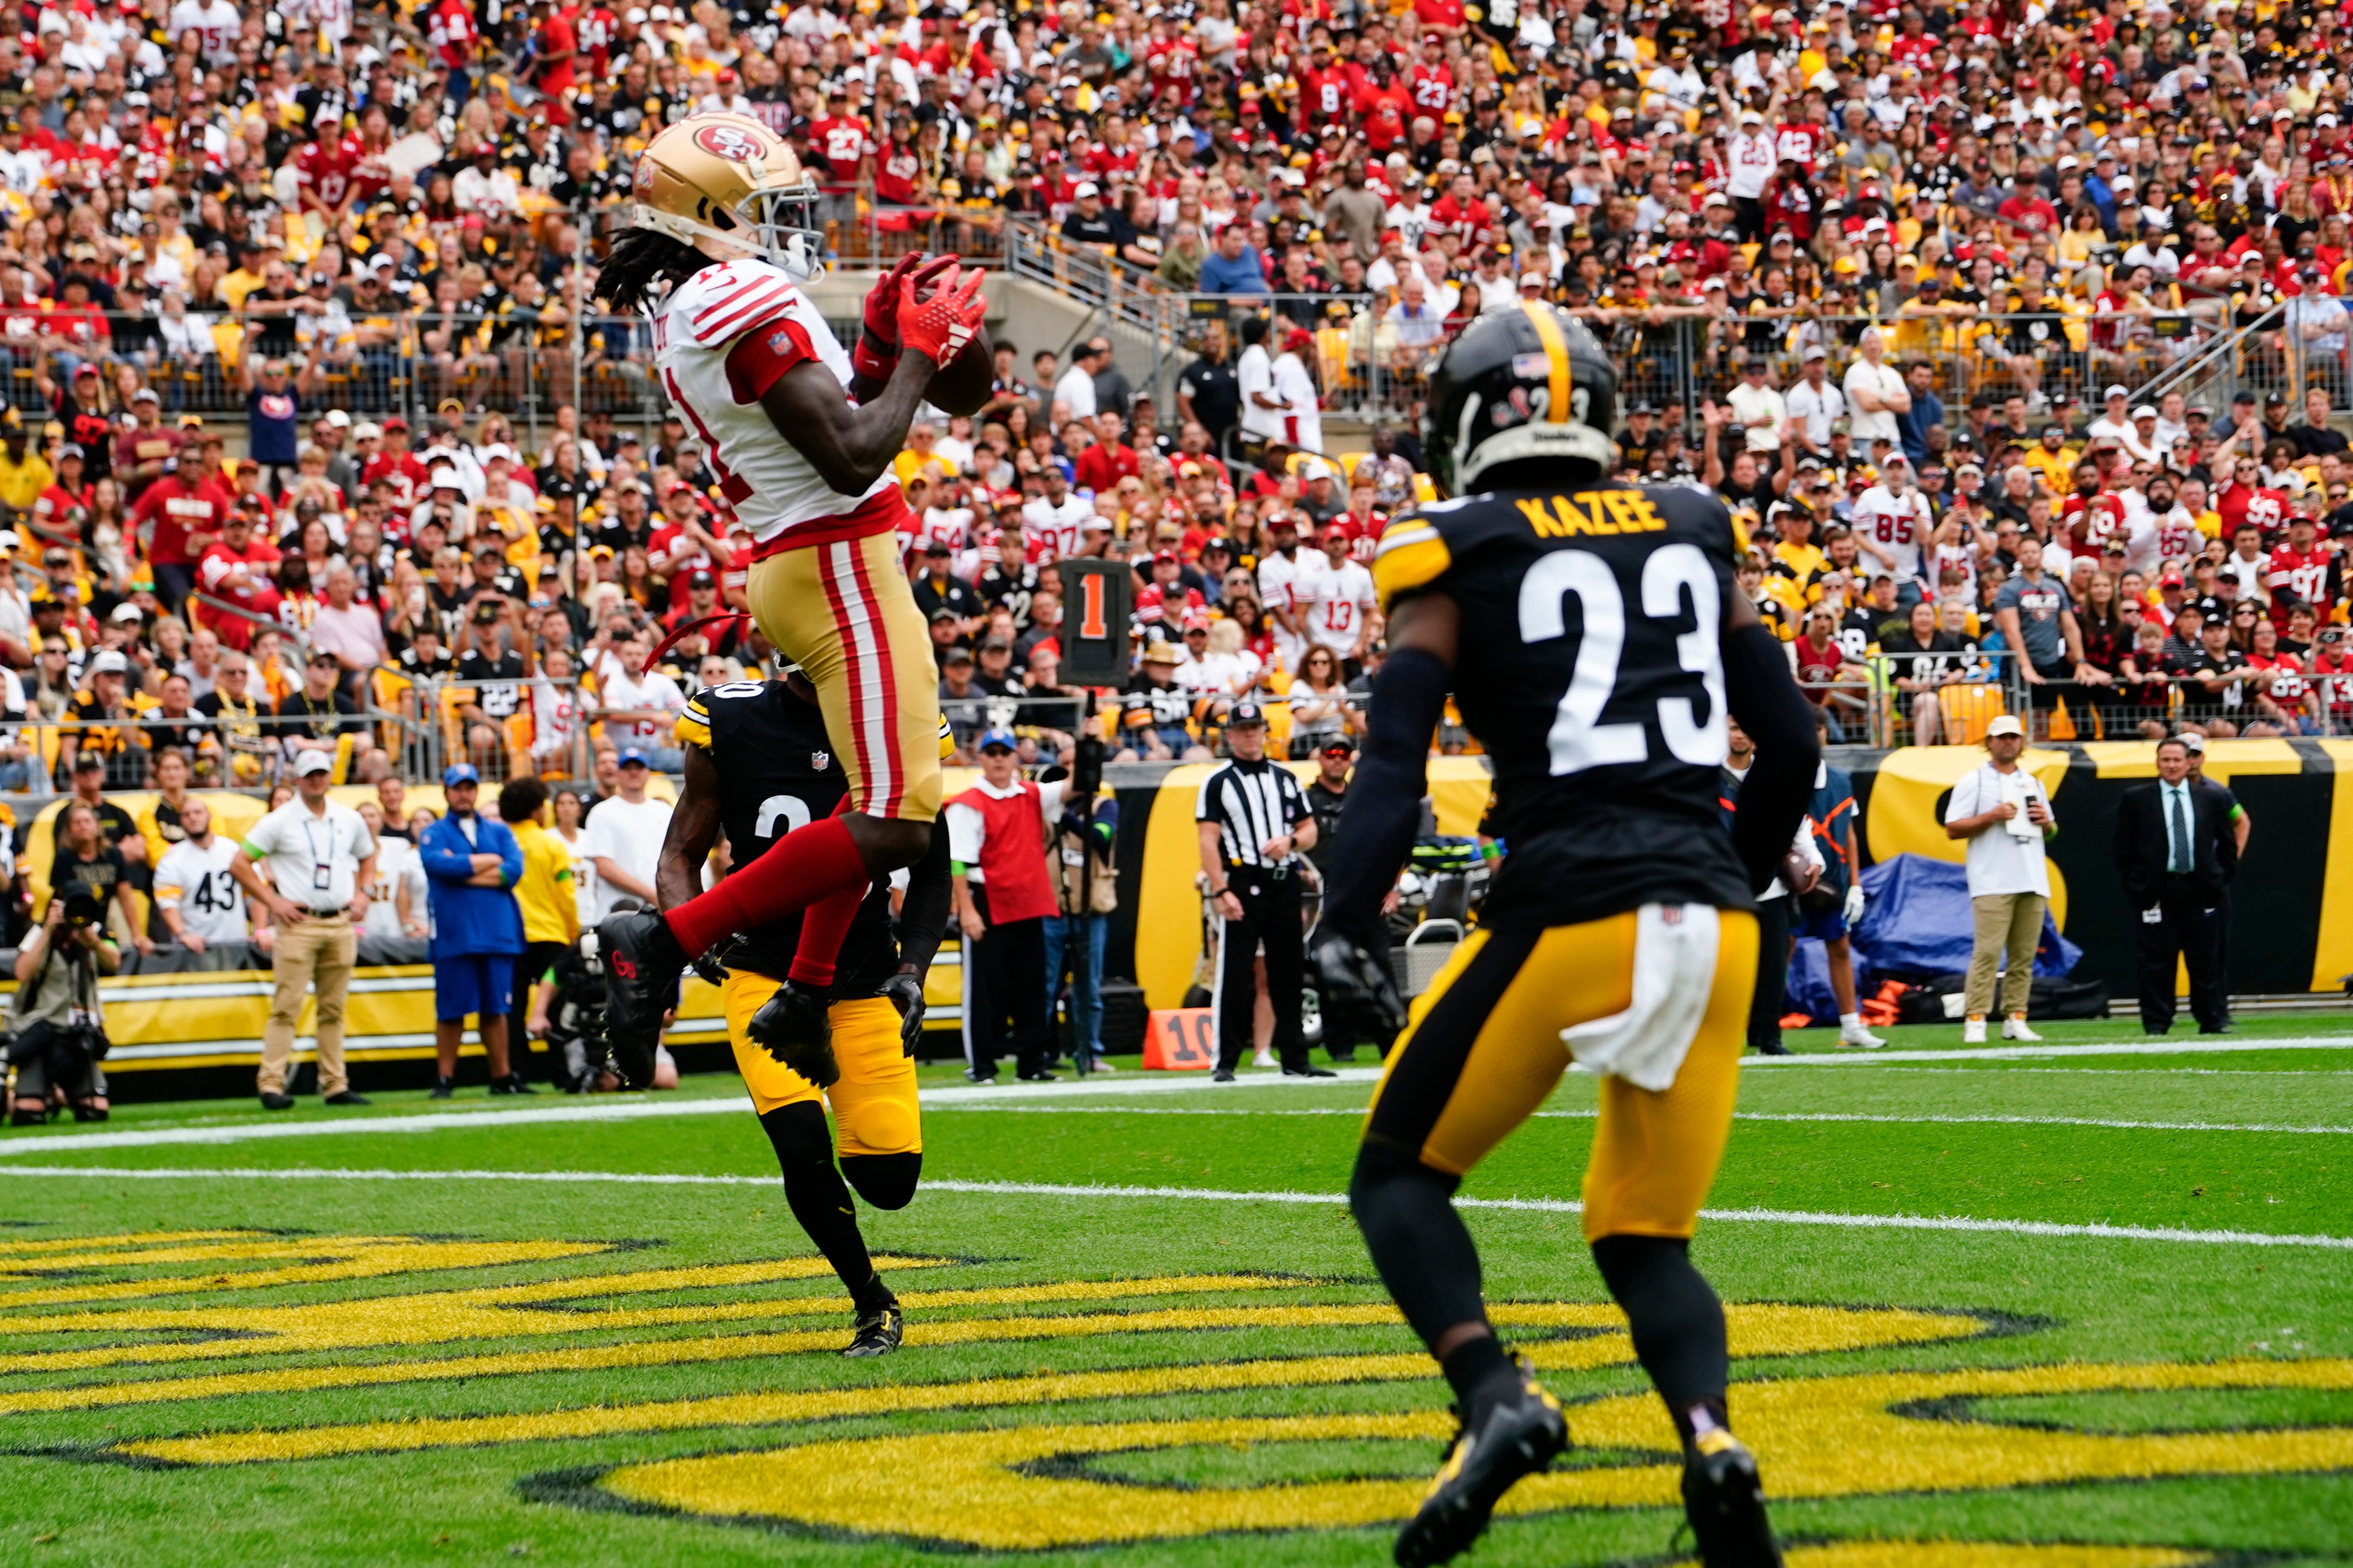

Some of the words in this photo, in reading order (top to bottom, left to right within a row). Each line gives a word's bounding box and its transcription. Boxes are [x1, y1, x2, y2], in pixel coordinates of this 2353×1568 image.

[1321, 83, 1339, 112] 8
[1415, 79, 1448, 108] 23
[826, 128, 863, 161] 23
[1776, 131, 1813, 163] 42
[1515, 490, 1667, 538] KAZEE
[2246, 495, 2281, 526] 95
[1041, 527, 1077, 559] 97
[1876, 514, 1914, 544] 85
[2290, 565, 2327, 604] 97
[1080, 573, 1107, 640] 1
[1327, 600, 1354, 631] 13
[1518, 543, 1729, 776] 23
[194, 872, 236, 914] 43
